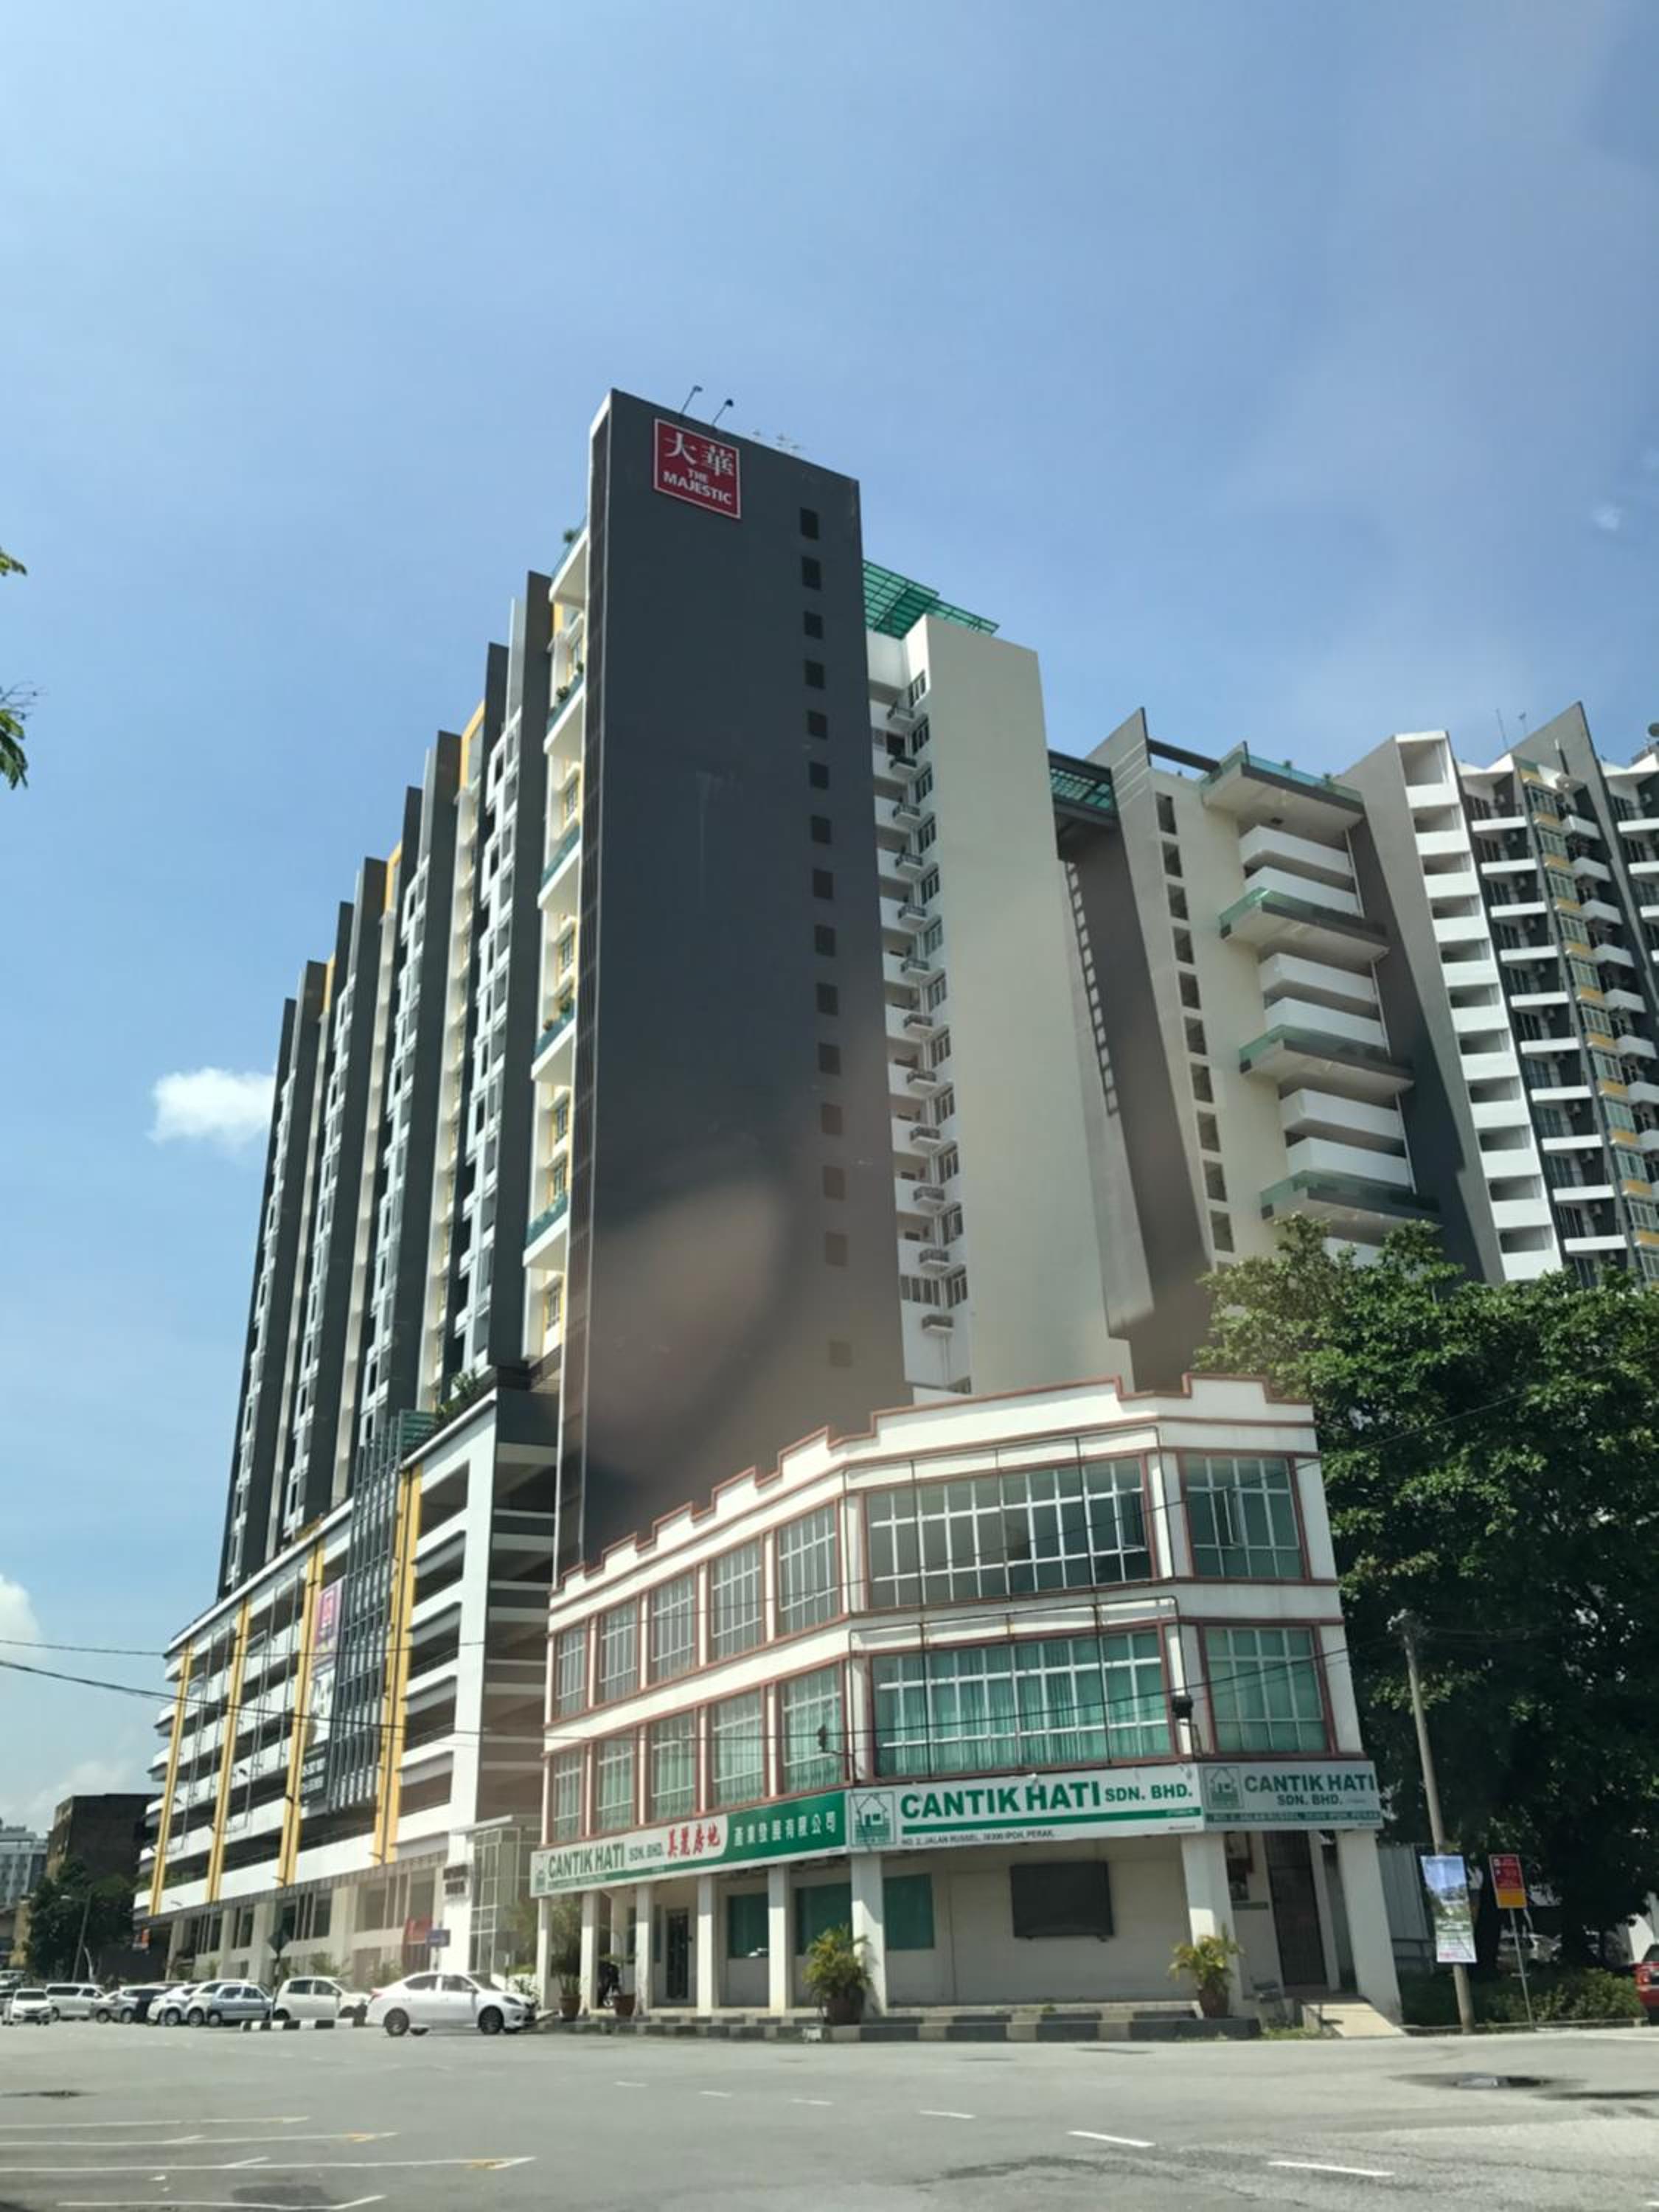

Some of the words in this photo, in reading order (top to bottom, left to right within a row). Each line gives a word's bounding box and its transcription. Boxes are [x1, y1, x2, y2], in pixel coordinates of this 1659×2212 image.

[664, 431, 735, 477] 大華
[663, 470, 732, 505] MAJESTIC
[687, 467, 709, 484] THE
[900, 1787, 1020, 1819] CANTIK
[1026, 1781, 1101, 1812] HATI
[1105, 1786, 1146, 1802] SDN.
[1151, 1783, 1193, 1800] BHD.
[1244, 1775, 1324, 1792] CANTIK
[1328, 1773, 1376, 1792] HATI
[1277, 1794, 1309, 1806] SDN.
[1312, 1794, 1343, 1806] BHD.
[547, 1847, 593, 1879] CANTIK
[595, 1842, 625, 1871] HATI
